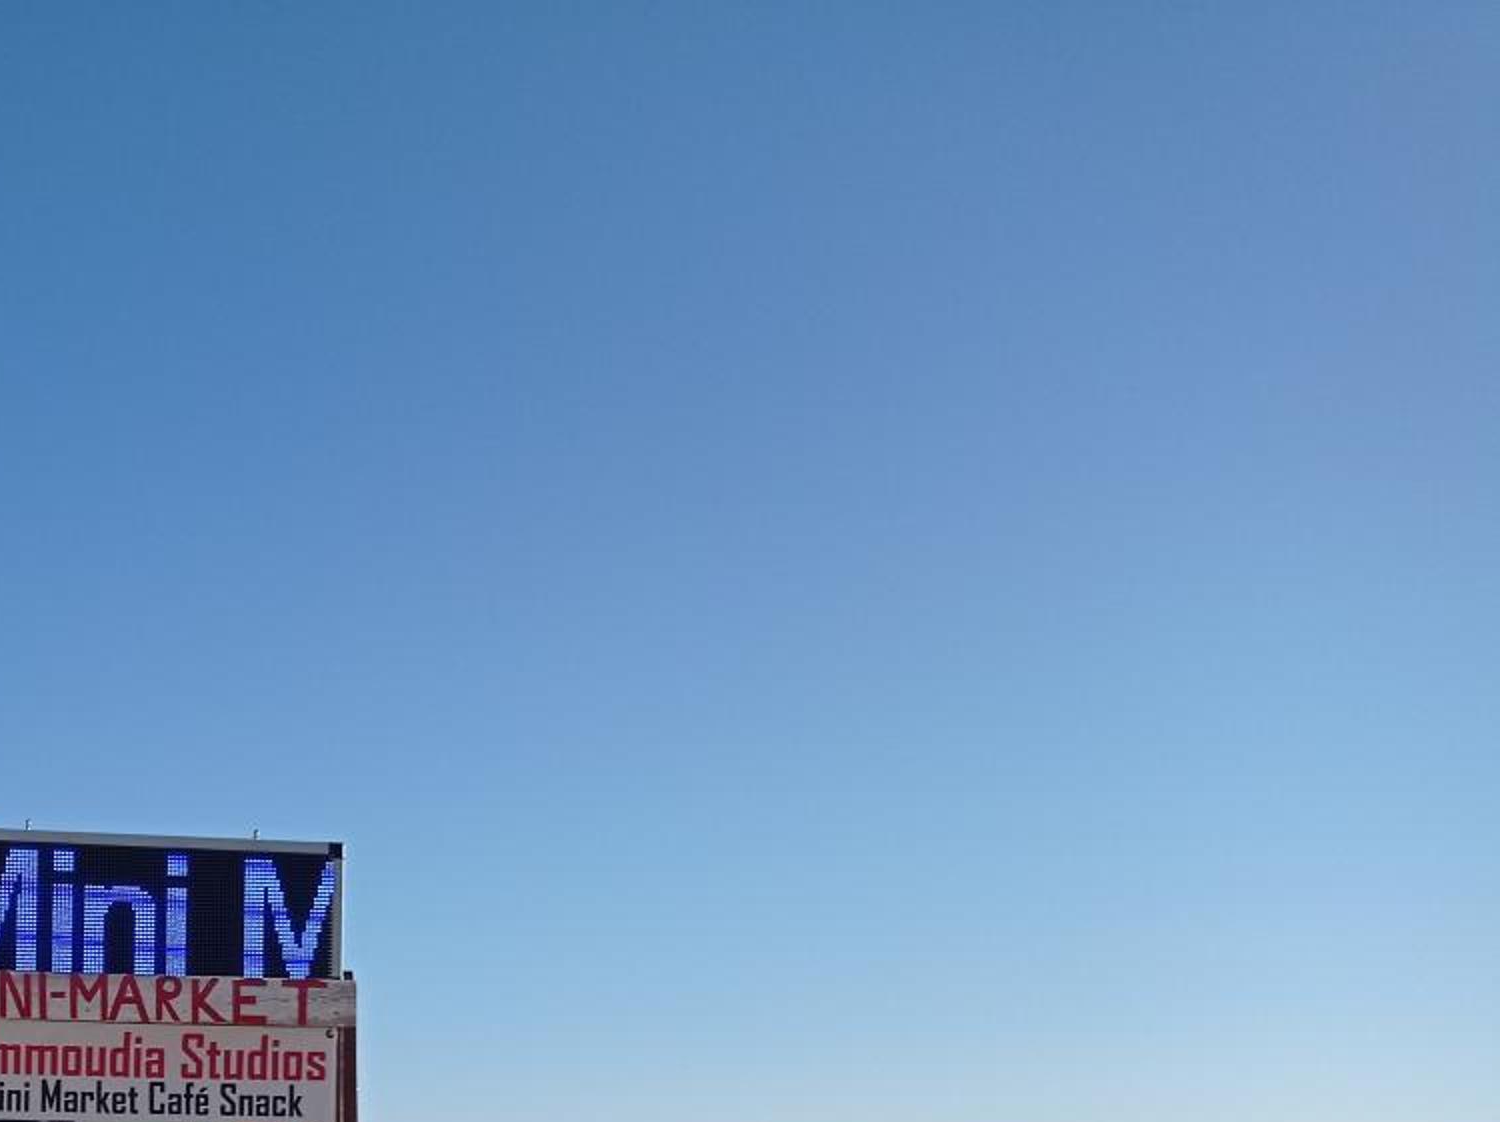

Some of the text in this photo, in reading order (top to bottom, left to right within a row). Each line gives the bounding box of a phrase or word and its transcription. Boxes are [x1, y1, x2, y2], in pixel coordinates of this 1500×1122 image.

[181, 1033, 326, 1081] Studios
[41, 1079, 138, 1114] Market
[149, 1081, 209, 1116] Café
[220, 1083, 303, 1117] Snack
